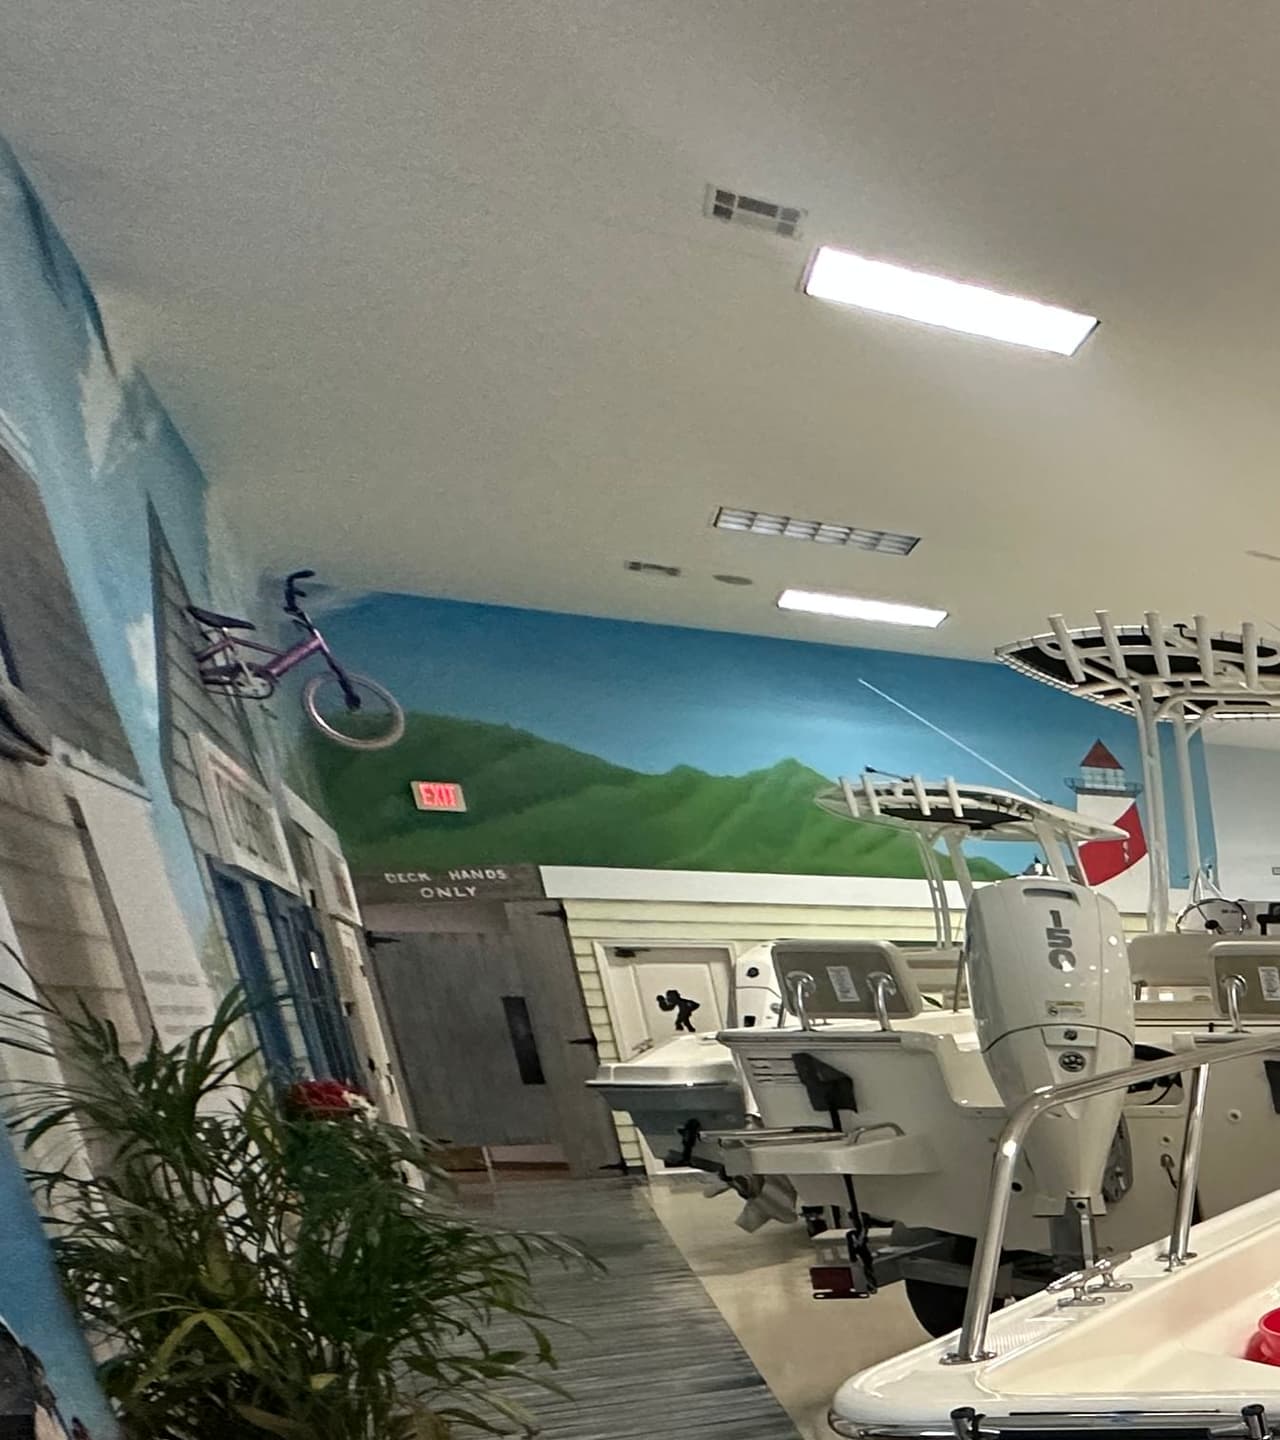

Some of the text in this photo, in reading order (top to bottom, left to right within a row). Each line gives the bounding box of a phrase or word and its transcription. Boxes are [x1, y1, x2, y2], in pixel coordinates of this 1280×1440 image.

[419, 783, 457, 807] EXIT
[384, 868, 507, 885] DECK HANDS
[420, 886, 477, 898] ONLY
[1046, 910, 1076, 974] 150
